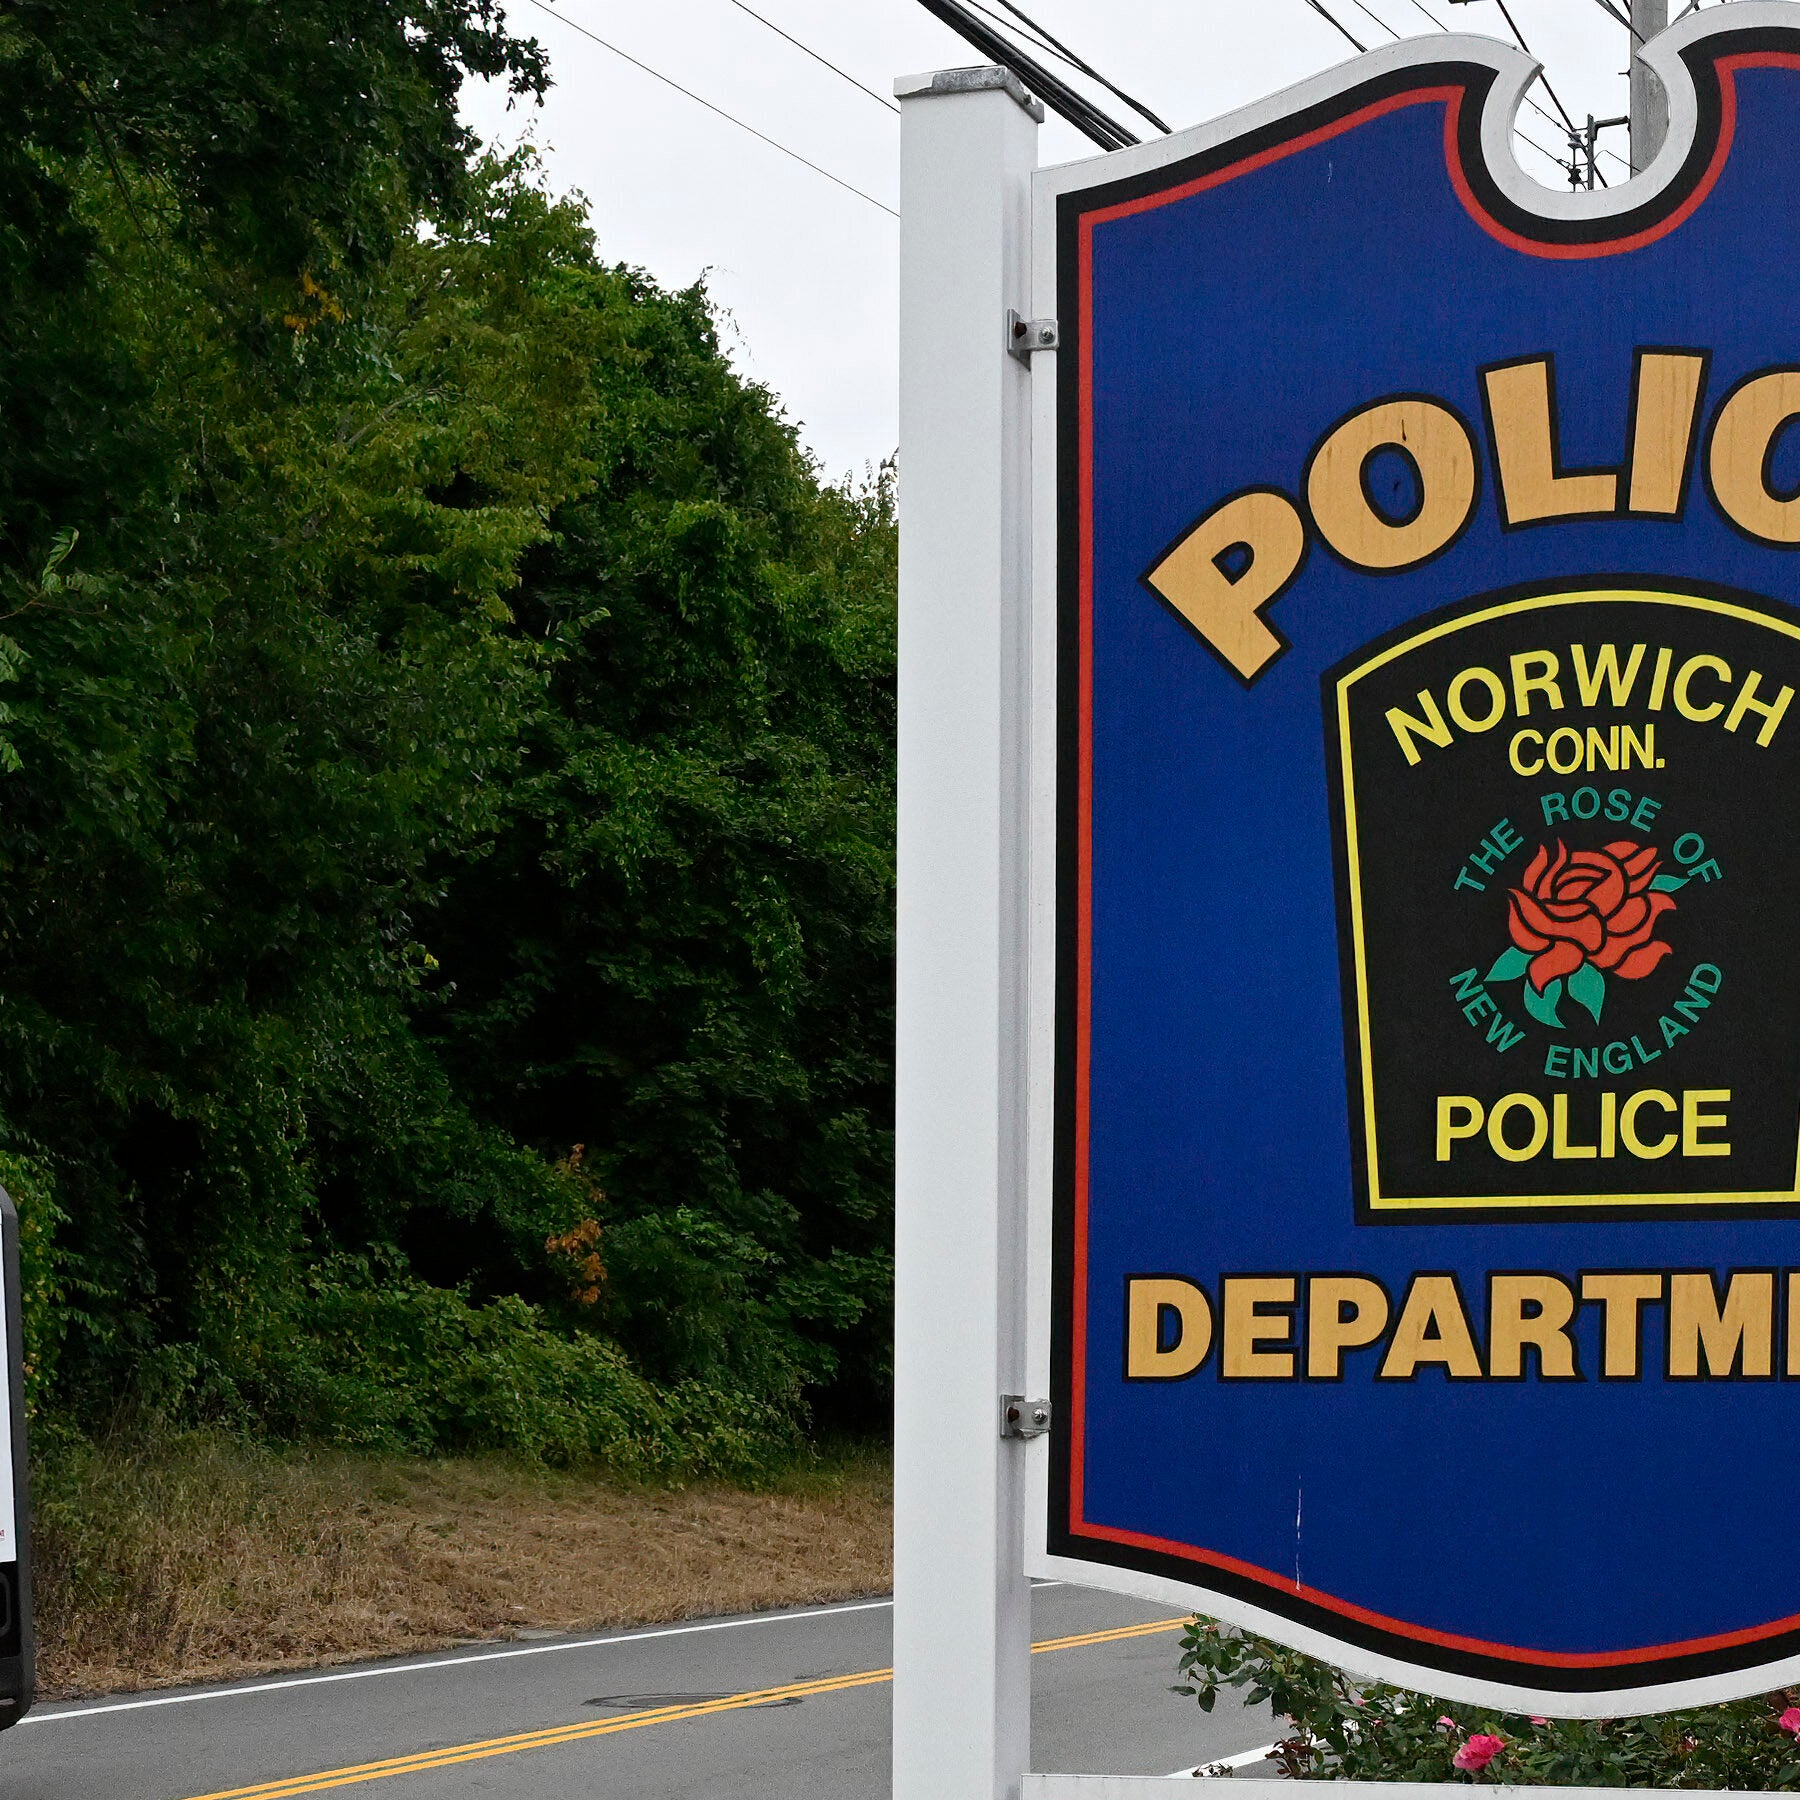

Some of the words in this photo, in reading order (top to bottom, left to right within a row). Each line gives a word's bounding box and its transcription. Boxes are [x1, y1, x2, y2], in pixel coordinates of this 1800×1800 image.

[1385, 642, 1794, 766] NORWICH
[1509, 724, 1665, 776] CONN.
[1454, 818, 1524, 895] THE
[1540, 786, 1663, 832] ROSE
[1673, 831, 1723, 884] OF
[1449, 967, 1526, 1053] NEW
[1544, 962, 1722, 1079] ENGLAND
[1436, 1089, 1731, 1162] POLICE
